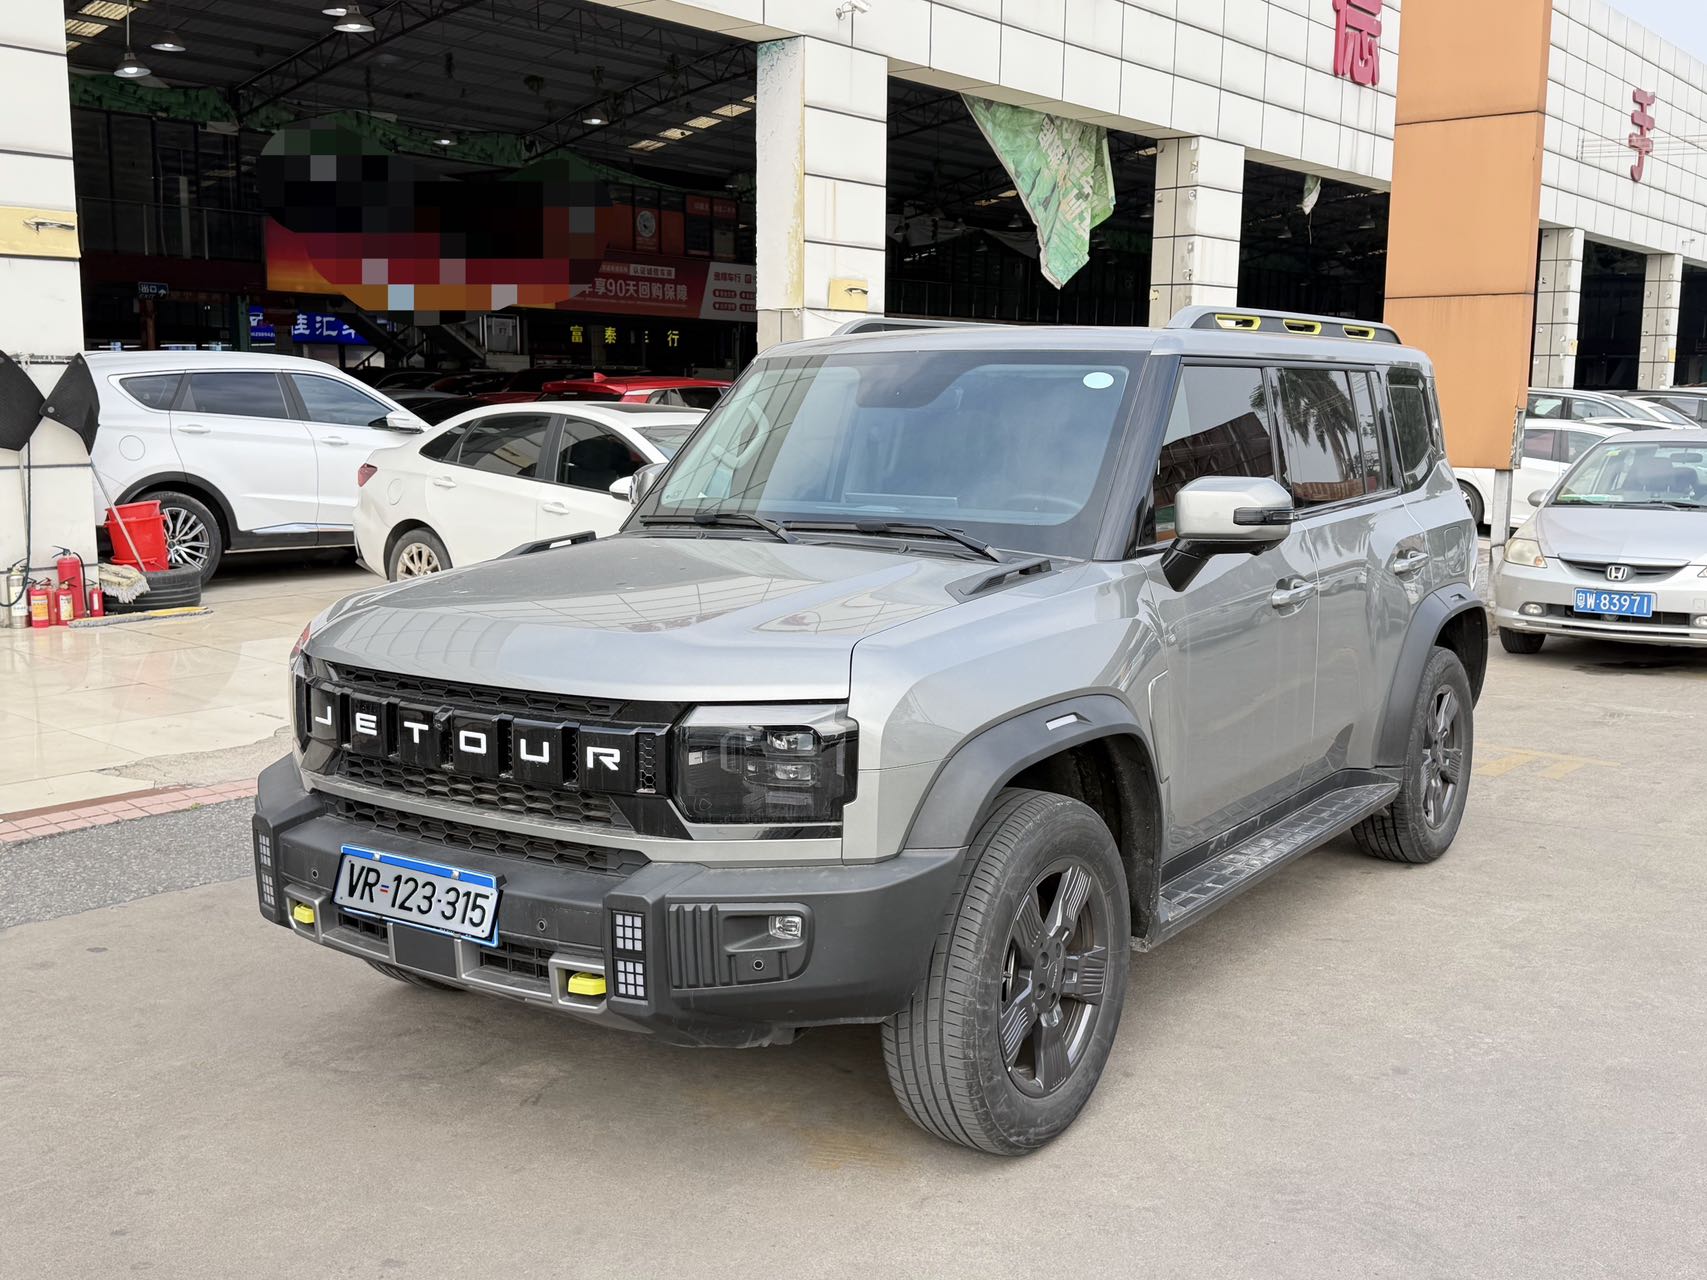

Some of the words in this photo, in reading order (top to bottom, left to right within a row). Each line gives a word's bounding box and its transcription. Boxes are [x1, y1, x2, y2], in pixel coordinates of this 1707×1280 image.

[569, 325, 680, 348] 富泰行
[315, 705, 622, 772] JETOUR
